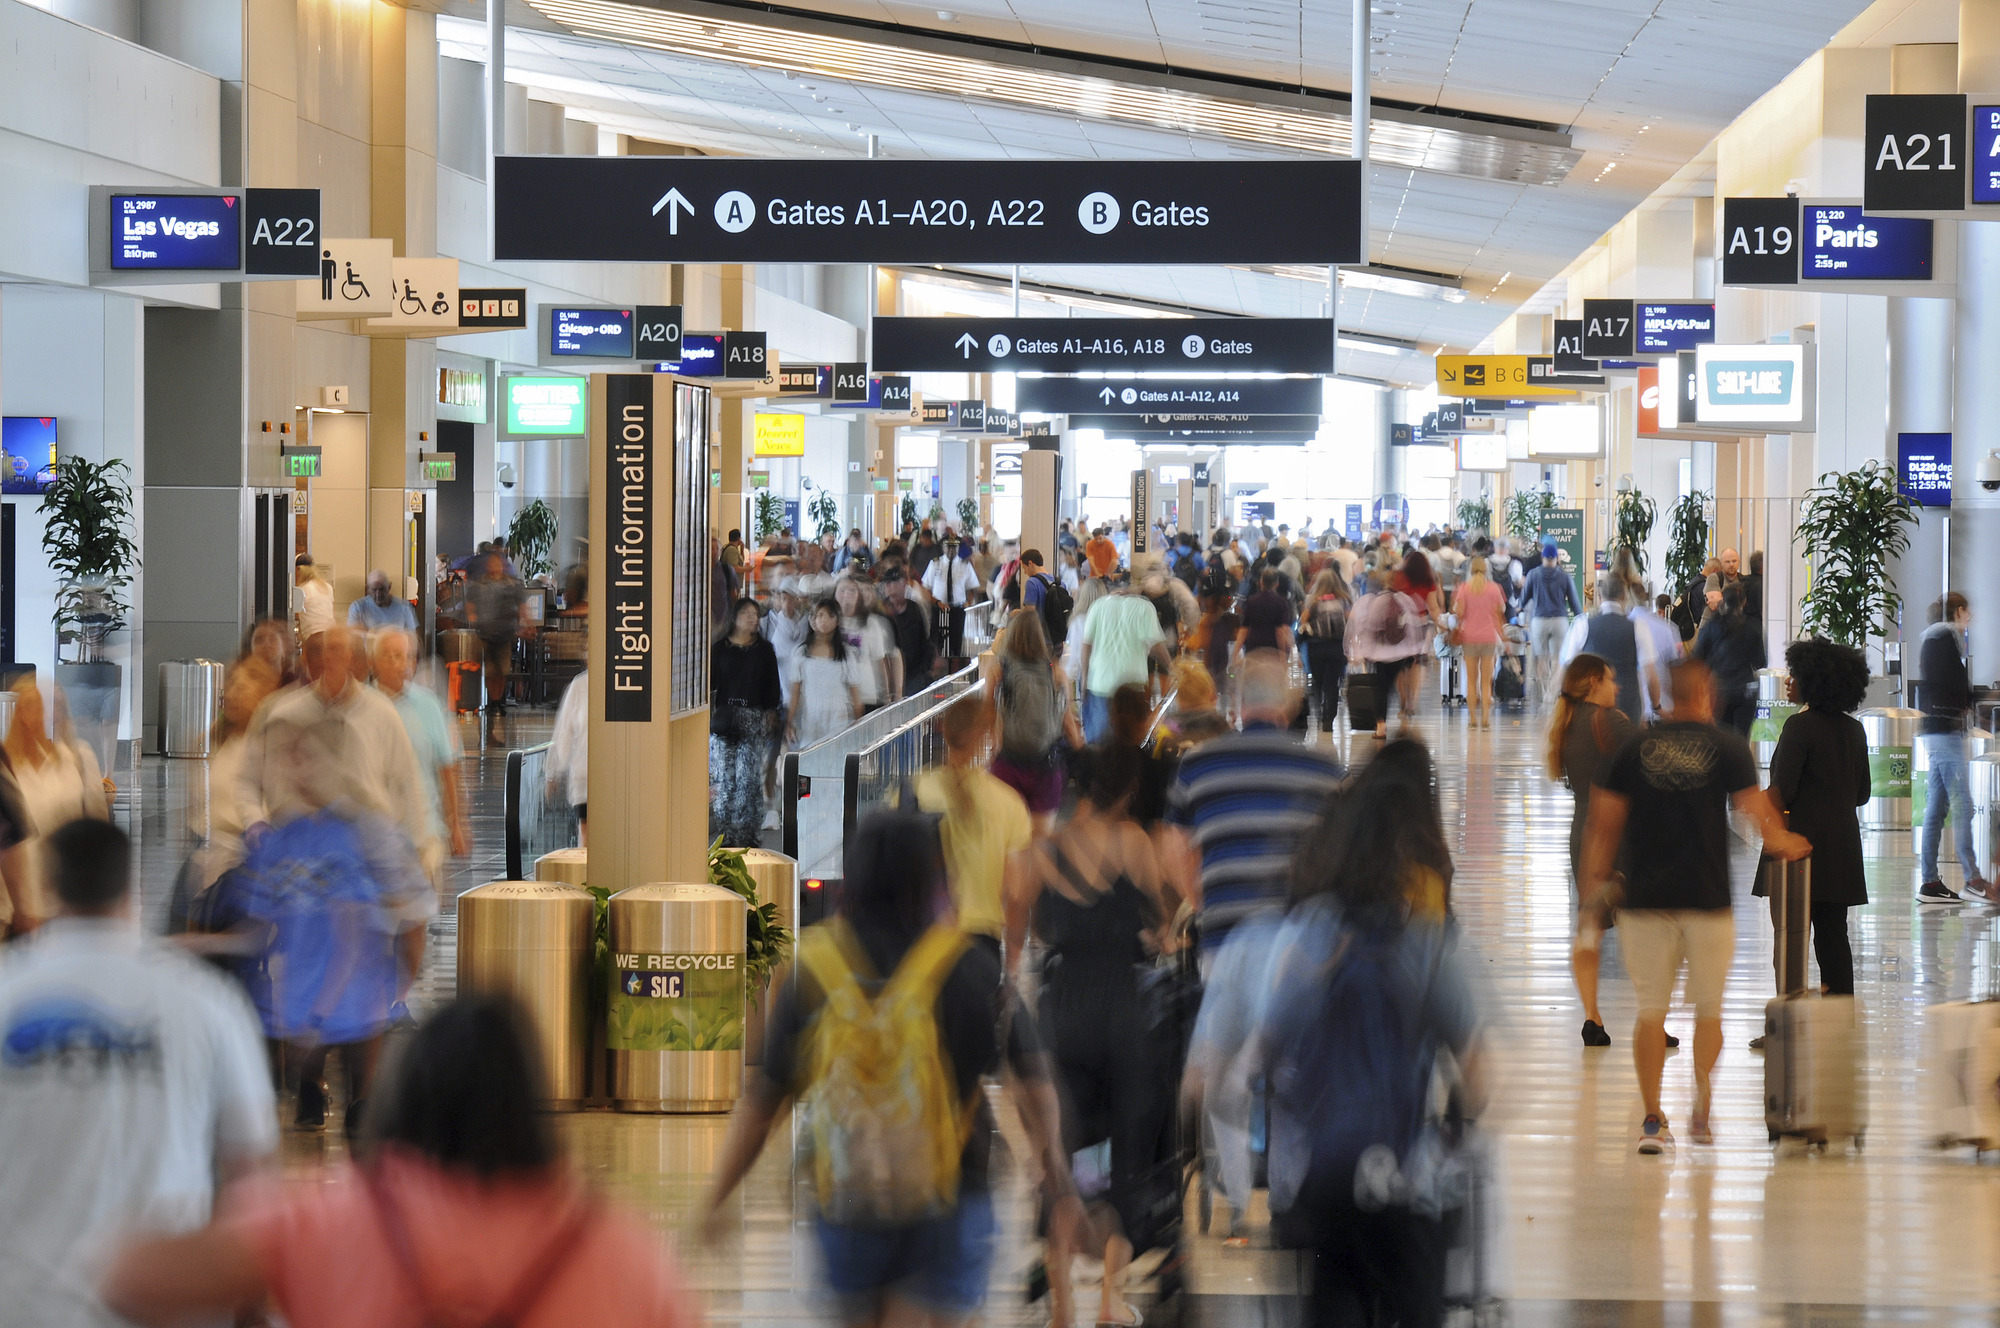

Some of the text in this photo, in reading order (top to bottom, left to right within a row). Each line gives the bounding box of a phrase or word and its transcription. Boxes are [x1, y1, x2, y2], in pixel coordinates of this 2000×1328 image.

[1876, 134, 1955, 170] A21
[122, 200, 135, 210] DL
[727, 201, 742, 223] A
[768, 199, 844, 224] Gates
[988, 200, 1043, 225] A22
[1093, 202, 1107, 224] B
[1132, 200, 1209, 225] Gates
[1815, 210, 1846, 220] DL 220
[123, 216, 219, 240] Las Vegas
[253, 218, 314, 245] A22
[1729, 227, 1792, 254] A19
[1815, 223, 1879, 249] Paris
[1814, 259, 1834, 269] 2:55
[558, 322, 595, 337] Chicago
[599, 323, 622, 335] ORD
[640, 324, 678, 342] A20
[1588, 318, 1629, 336] A17
[995, 340, 1004, 353] A
[1017, 339, 1058, 353] Gates
[1134, 340, 1164, 353] A18
[1190, 340, 1200, 353] B
[1211, 340, 1252, 353] Gates
[730, 347, 763, 362] A18
[838, 375, 865, 388] A16
[1496, 368, 1505, 382] B
[884, 387, 909, 399] A14
[1140, 391, 1168, 401] Gates
[1218, 391, 1239, 401] A14
[961, 407, 983, 420] A12
[987, 415, 1007, 426] A10
[1442, 410, 1457, 422] A9
[1036, 427, 1049, 436] A6
[290, 455, 318, 477] EXIT
[428, 461, 451, 479] EXIT
[1908, 462, 1937, 472] DL220
[1196, 471, 1208, 479] A2
[1918, 472, 1940, 481] Paris
[1918, 480, 1936, 490] 2:55
[1937, 480, 1951, 490] PM
[1136, 476, 1145, 521] Information
[615, 405, 650, 691] Flight Information
[1757, 709, 1770, 719] SLC
[616, 953, 734, 969] WE RECYCLE
[651, 976, 679, 998] SLC
